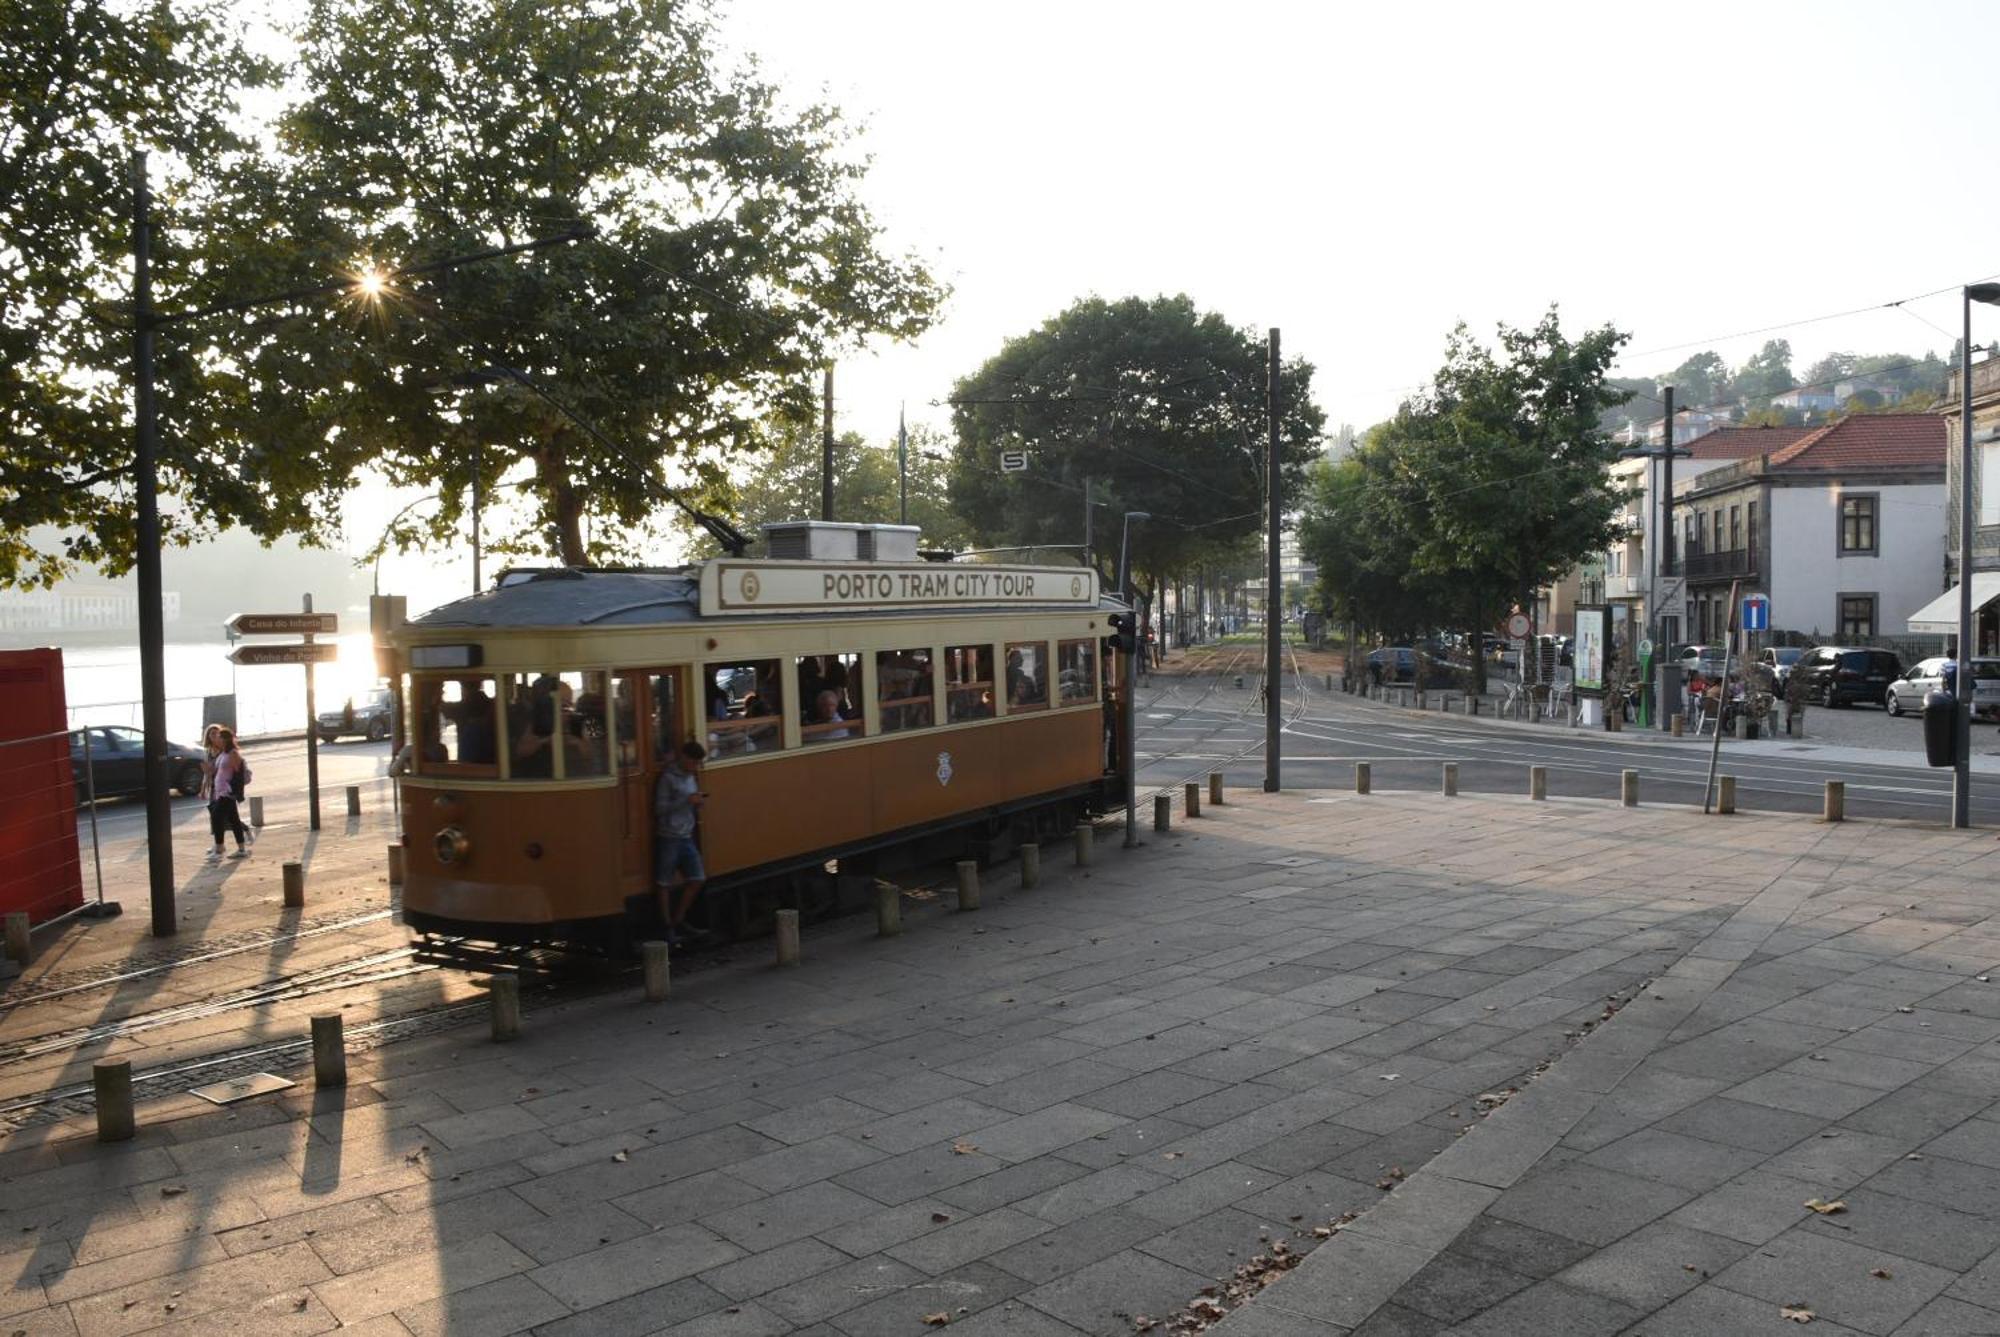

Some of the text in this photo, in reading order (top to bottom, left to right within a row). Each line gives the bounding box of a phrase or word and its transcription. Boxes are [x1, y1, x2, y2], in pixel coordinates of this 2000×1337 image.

[823, 573, 1034, 599] PORTO TRAM CITY TOUR
